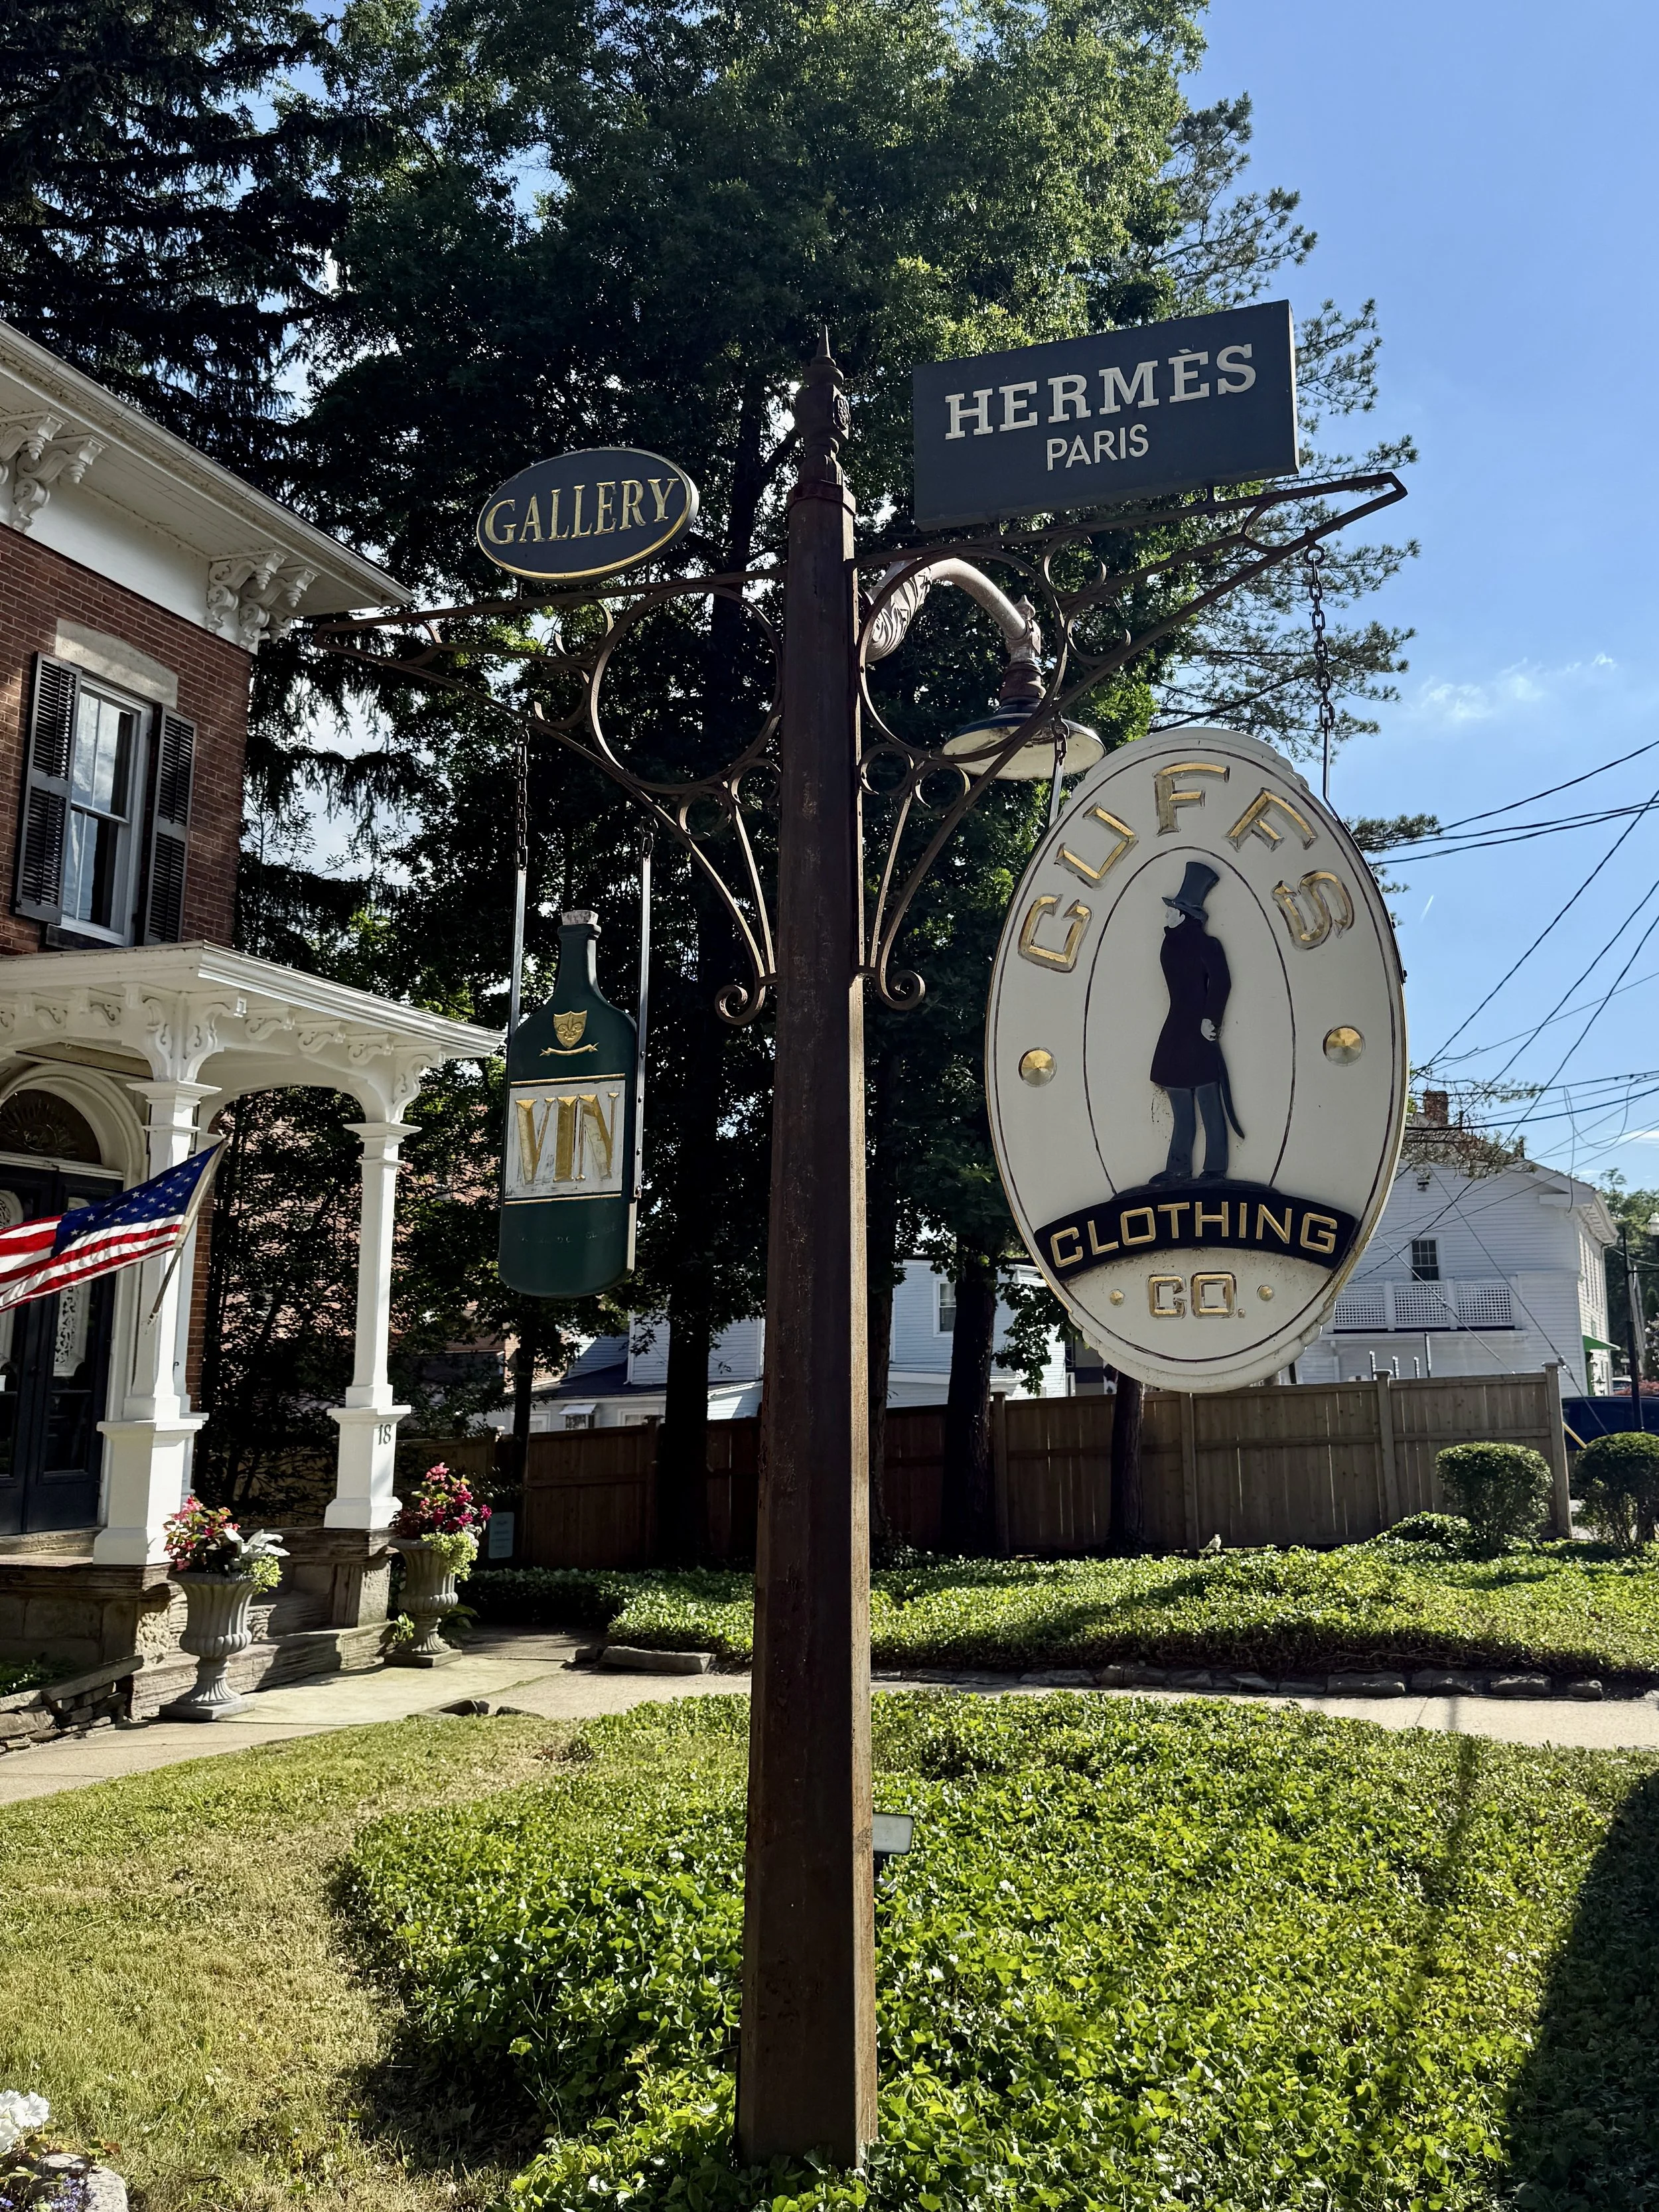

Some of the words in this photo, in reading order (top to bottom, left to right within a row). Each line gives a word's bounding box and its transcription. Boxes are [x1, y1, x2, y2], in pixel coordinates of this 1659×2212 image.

[945, 343, 1256, 440] HERMÈS
[1046, 423, 1149, 472] PARIS
[484, 478, 679, 545] GALLERY
[1017, 761, 1355, 973] CUFFS
[516, 1092, 619, 1185] VIN
[1050, 1201, 1337, 1268] CLOTHING
[1147, 1271, 1246, 1320] CO.
[378, 1424, 392, 1445] 18
